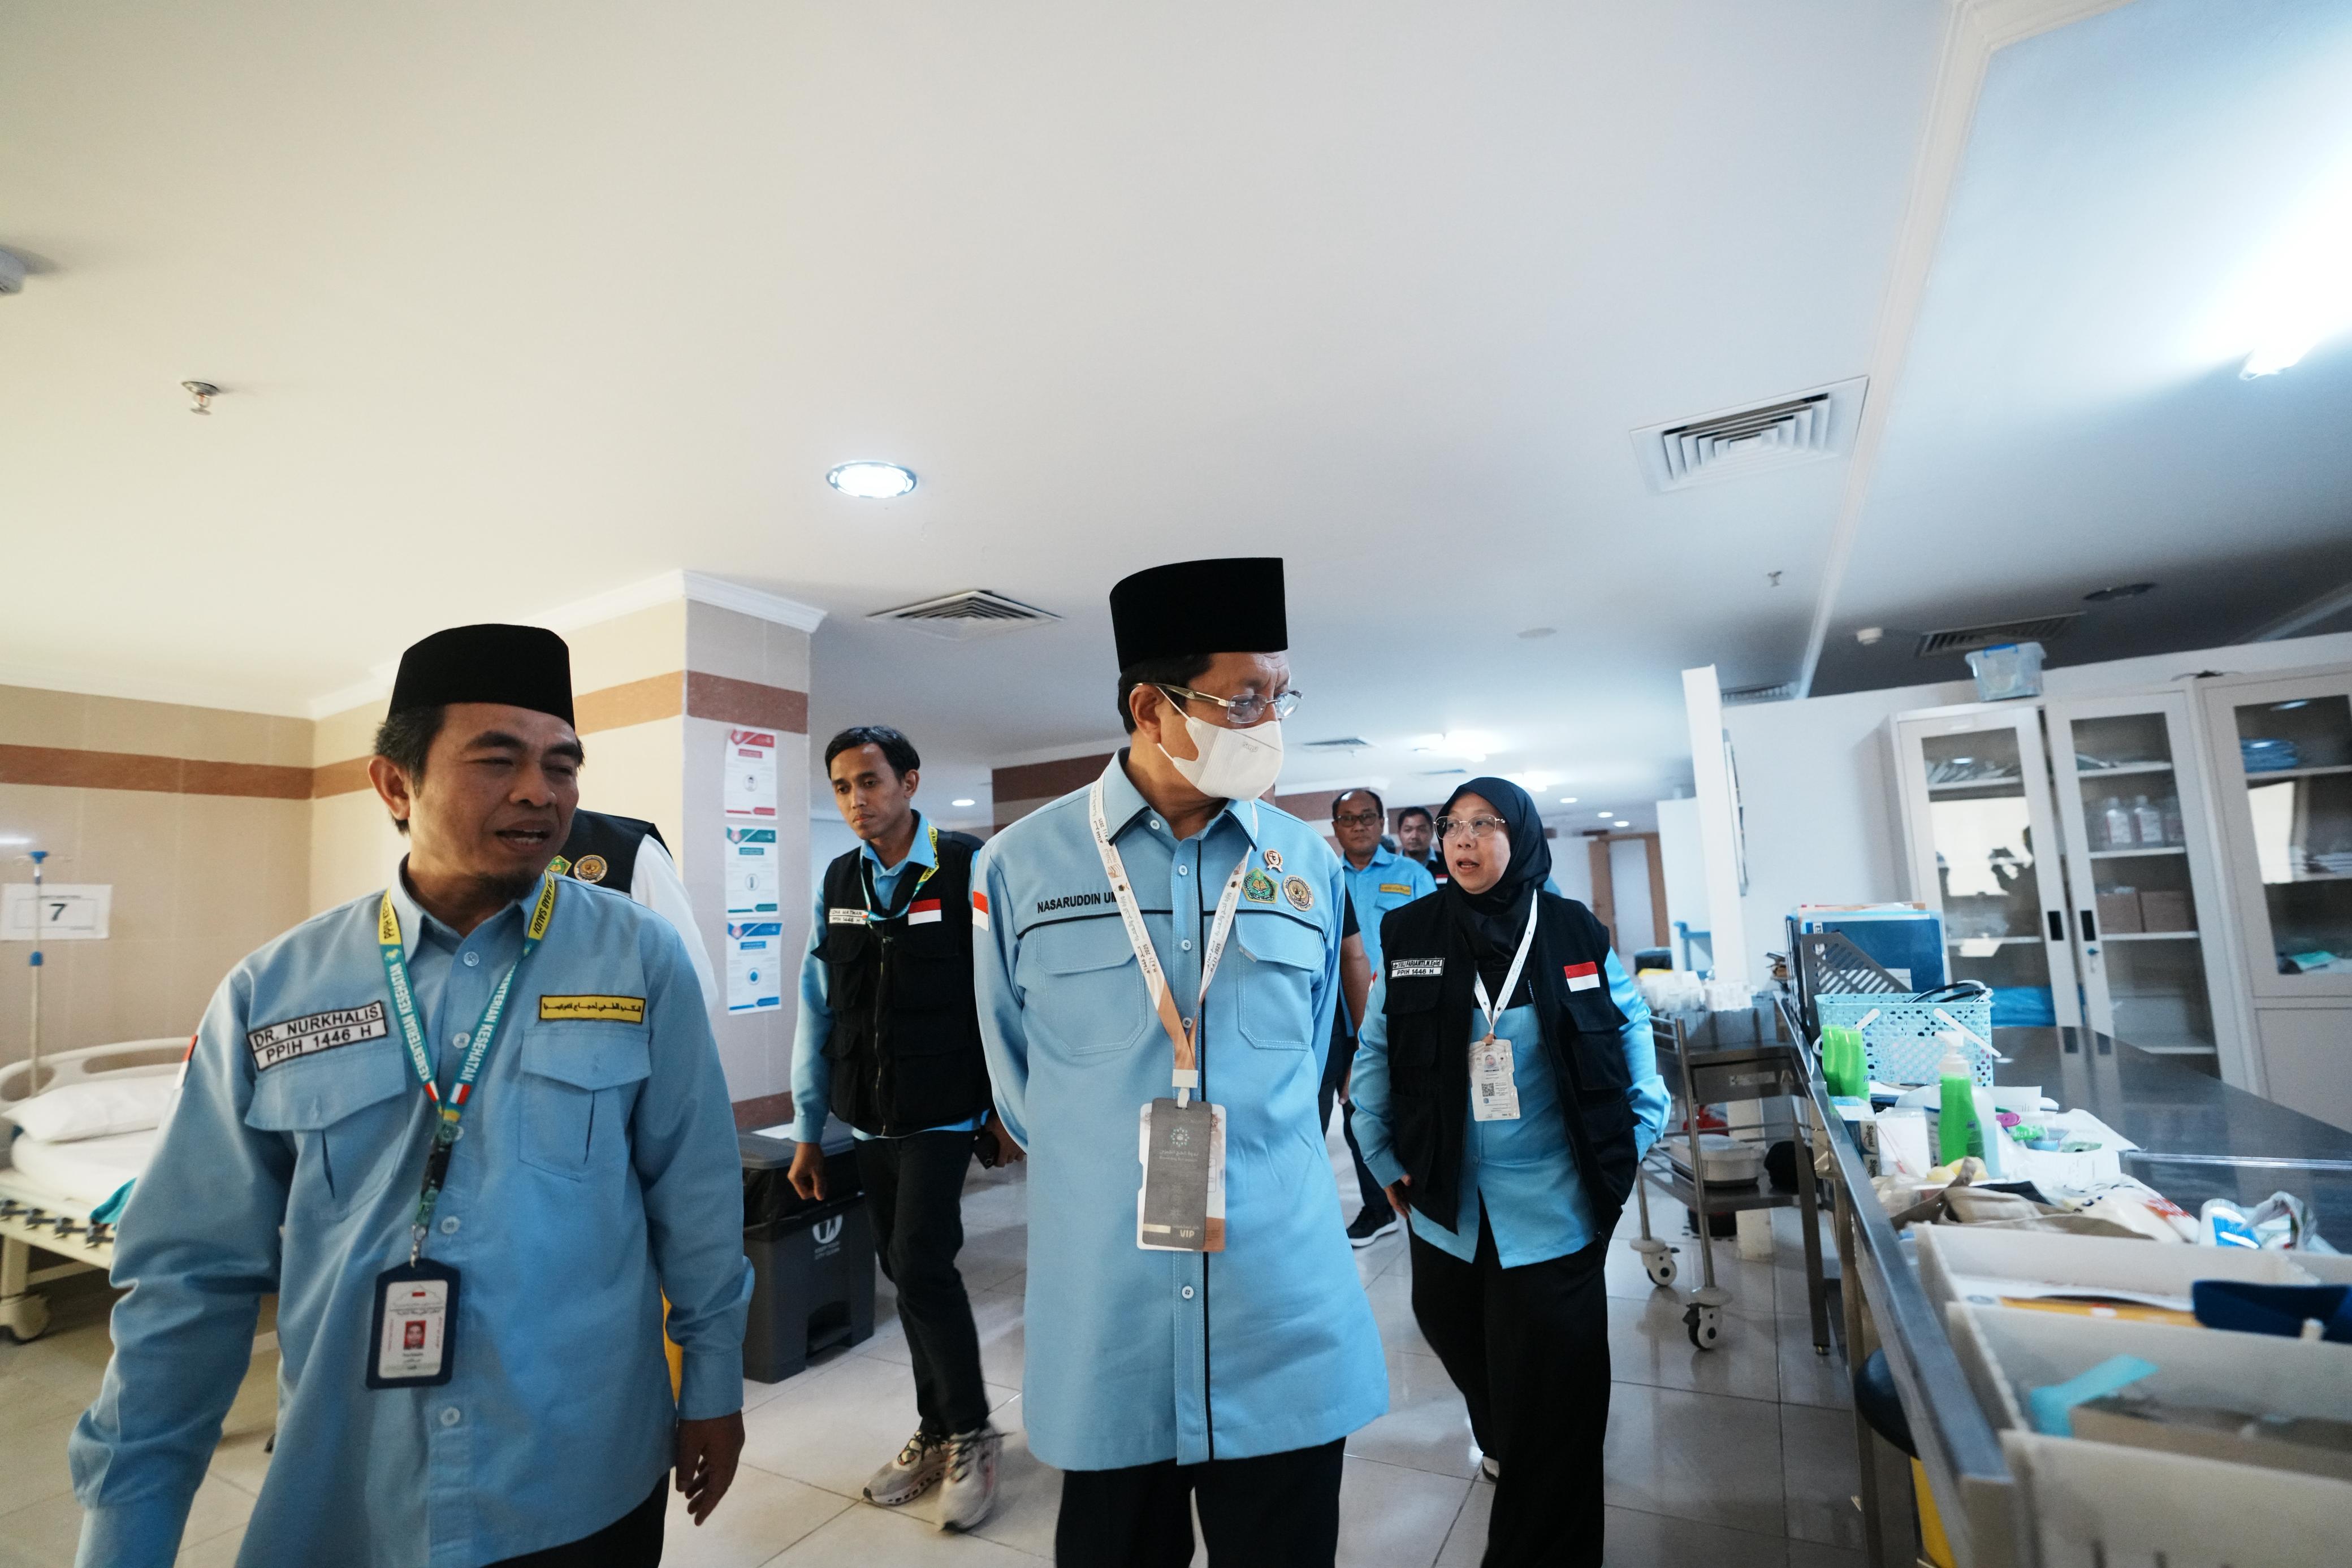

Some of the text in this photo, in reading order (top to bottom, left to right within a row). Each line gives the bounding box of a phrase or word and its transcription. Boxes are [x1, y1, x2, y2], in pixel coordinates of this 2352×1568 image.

[538, 887, 552, 909] ARAB
[1037, 893, 1100, 914] NASARUDDIN
[49, 903, 68, 922] 7
[533, 907, 549, 935] SAUDI
[389, 962, 413, 1016] KESEHATAN
[254, 1006, 379, 1047] DR. NURKHALIS
[266, 1025, 372, 1063] PPIH 1446 H
[460, 1020, 494, 1082] KESEHATAN
[1866, 1124, 1875, 1147] Signal
[1179, 1229, 1195, 1238] VIP
